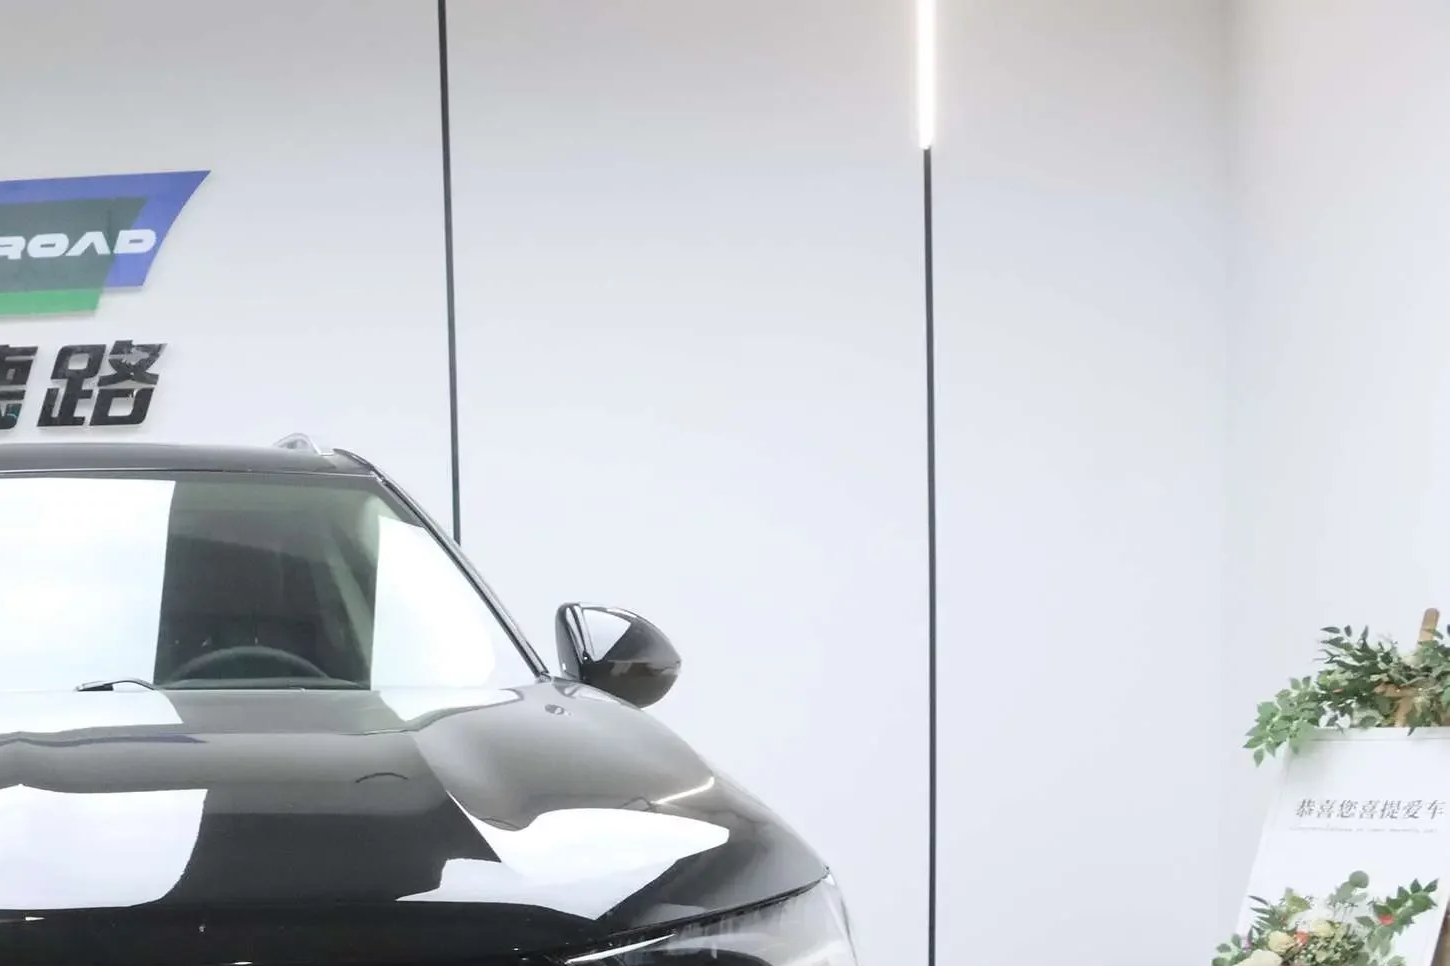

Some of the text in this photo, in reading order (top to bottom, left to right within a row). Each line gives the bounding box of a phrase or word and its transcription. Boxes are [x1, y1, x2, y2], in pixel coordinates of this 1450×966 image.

[1295, 799, 1446, 820] 恭喜您喜提爱车
